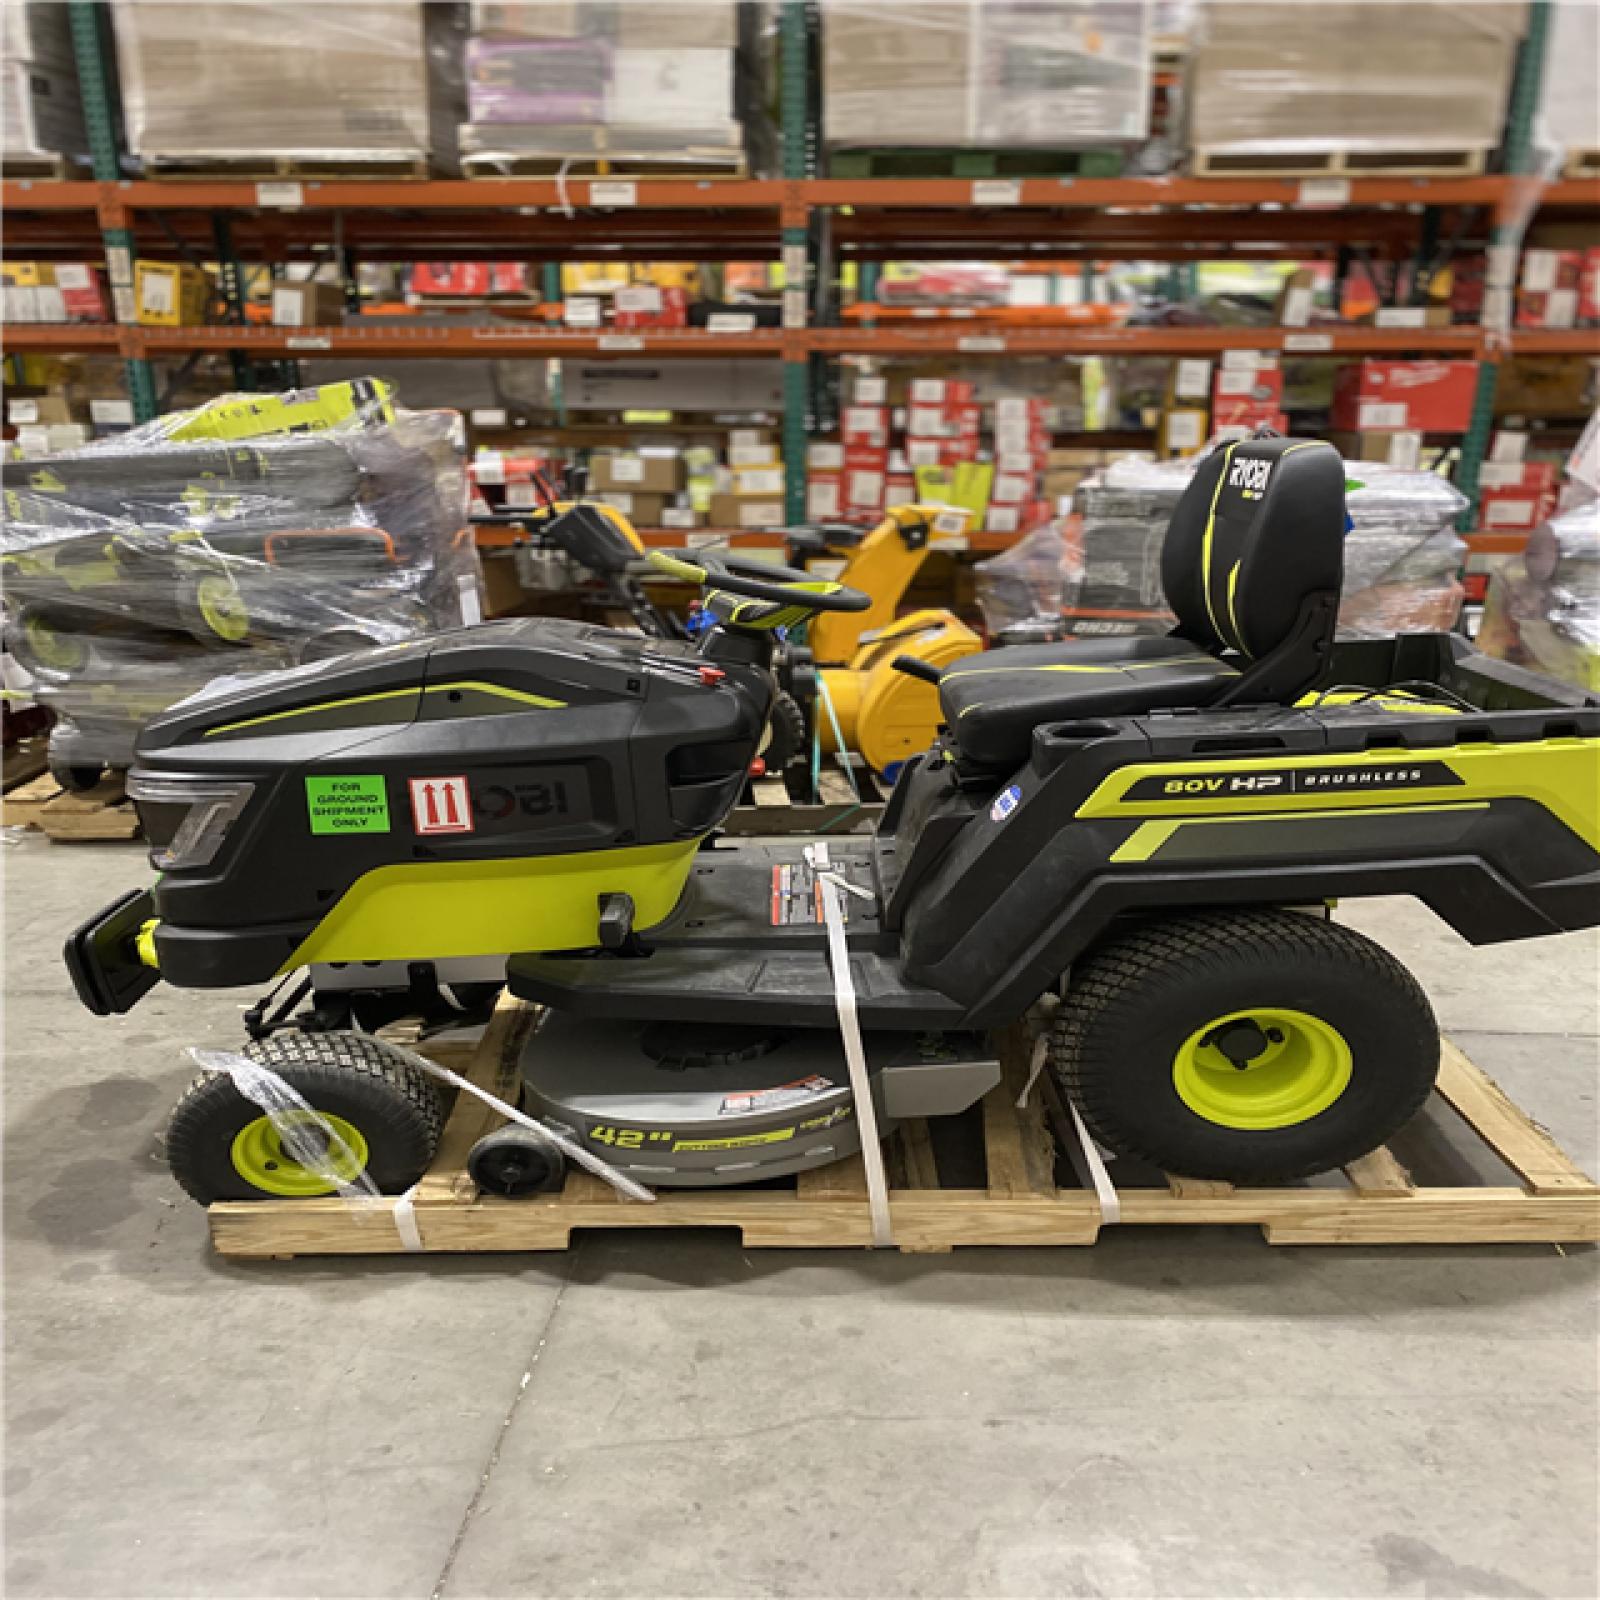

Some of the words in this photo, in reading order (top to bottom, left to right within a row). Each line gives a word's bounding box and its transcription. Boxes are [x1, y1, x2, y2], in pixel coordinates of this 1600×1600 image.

[1230, 774, 1283, 791] HP
[1304, 769, 1421, 786] BRUSHLESS
[332, 783, 360, 791] FOR
[317, 794, 378, 804] GROUND
[313, 806, 383, 815] SHIPMENT
[332, 818, 367, 827] ONLY
[590, 1126, 672, 1148] 42"
